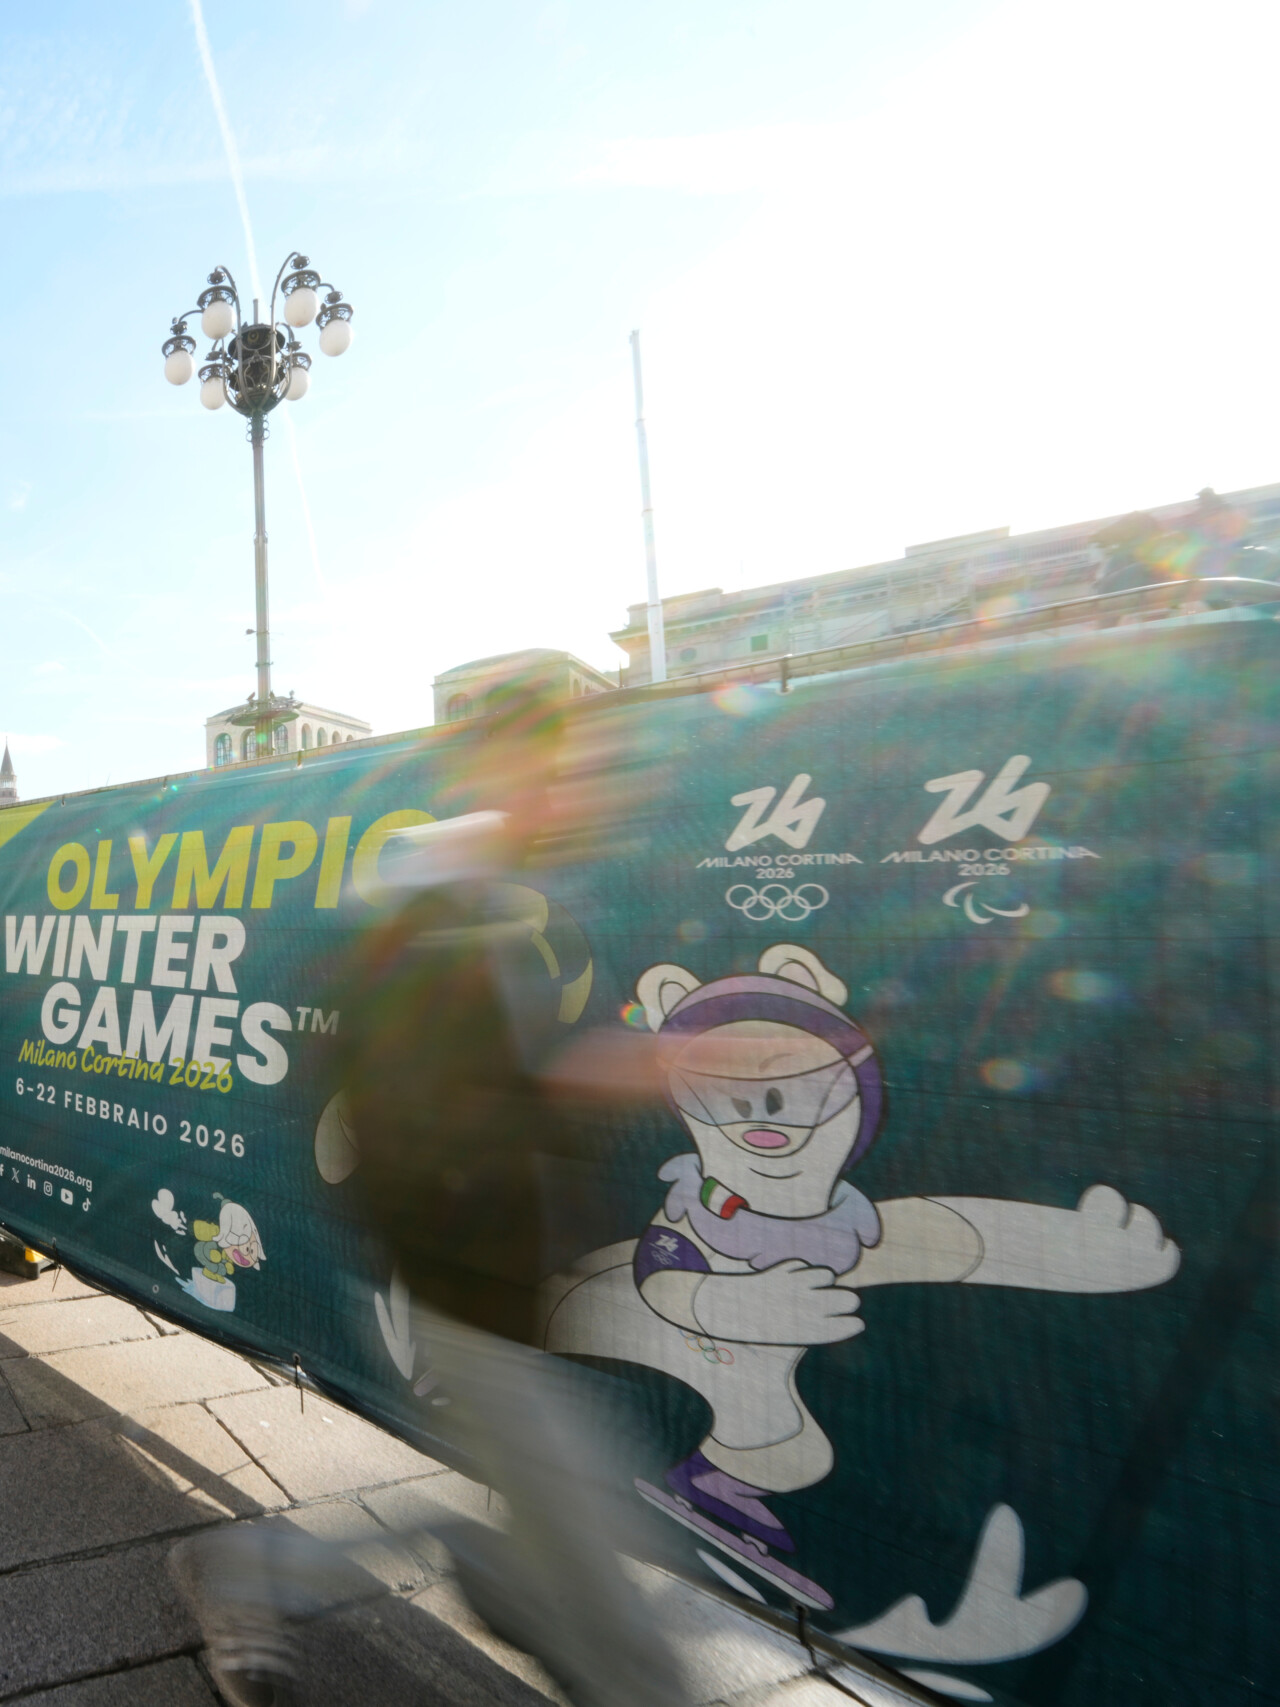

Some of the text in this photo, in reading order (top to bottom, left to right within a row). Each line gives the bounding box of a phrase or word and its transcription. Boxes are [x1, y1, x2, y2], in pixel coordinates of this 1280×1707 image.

[696, 853, 864, 868] MILANO CORTINA
[879, 846, 1103, 864] MILANO CORTINA
[958, 863, 1010, 876] 2026
[755, 868, 795, 879] 2026
[4, 915, 246, 993] WINTER
[18, 1038, 233, 1094] Milano Cortina 2026
[15, 1078, 246, 1158] 6-22 FEBBRAIO 2026
[0, 1146, 93, 1193] milanocortina2026.org
